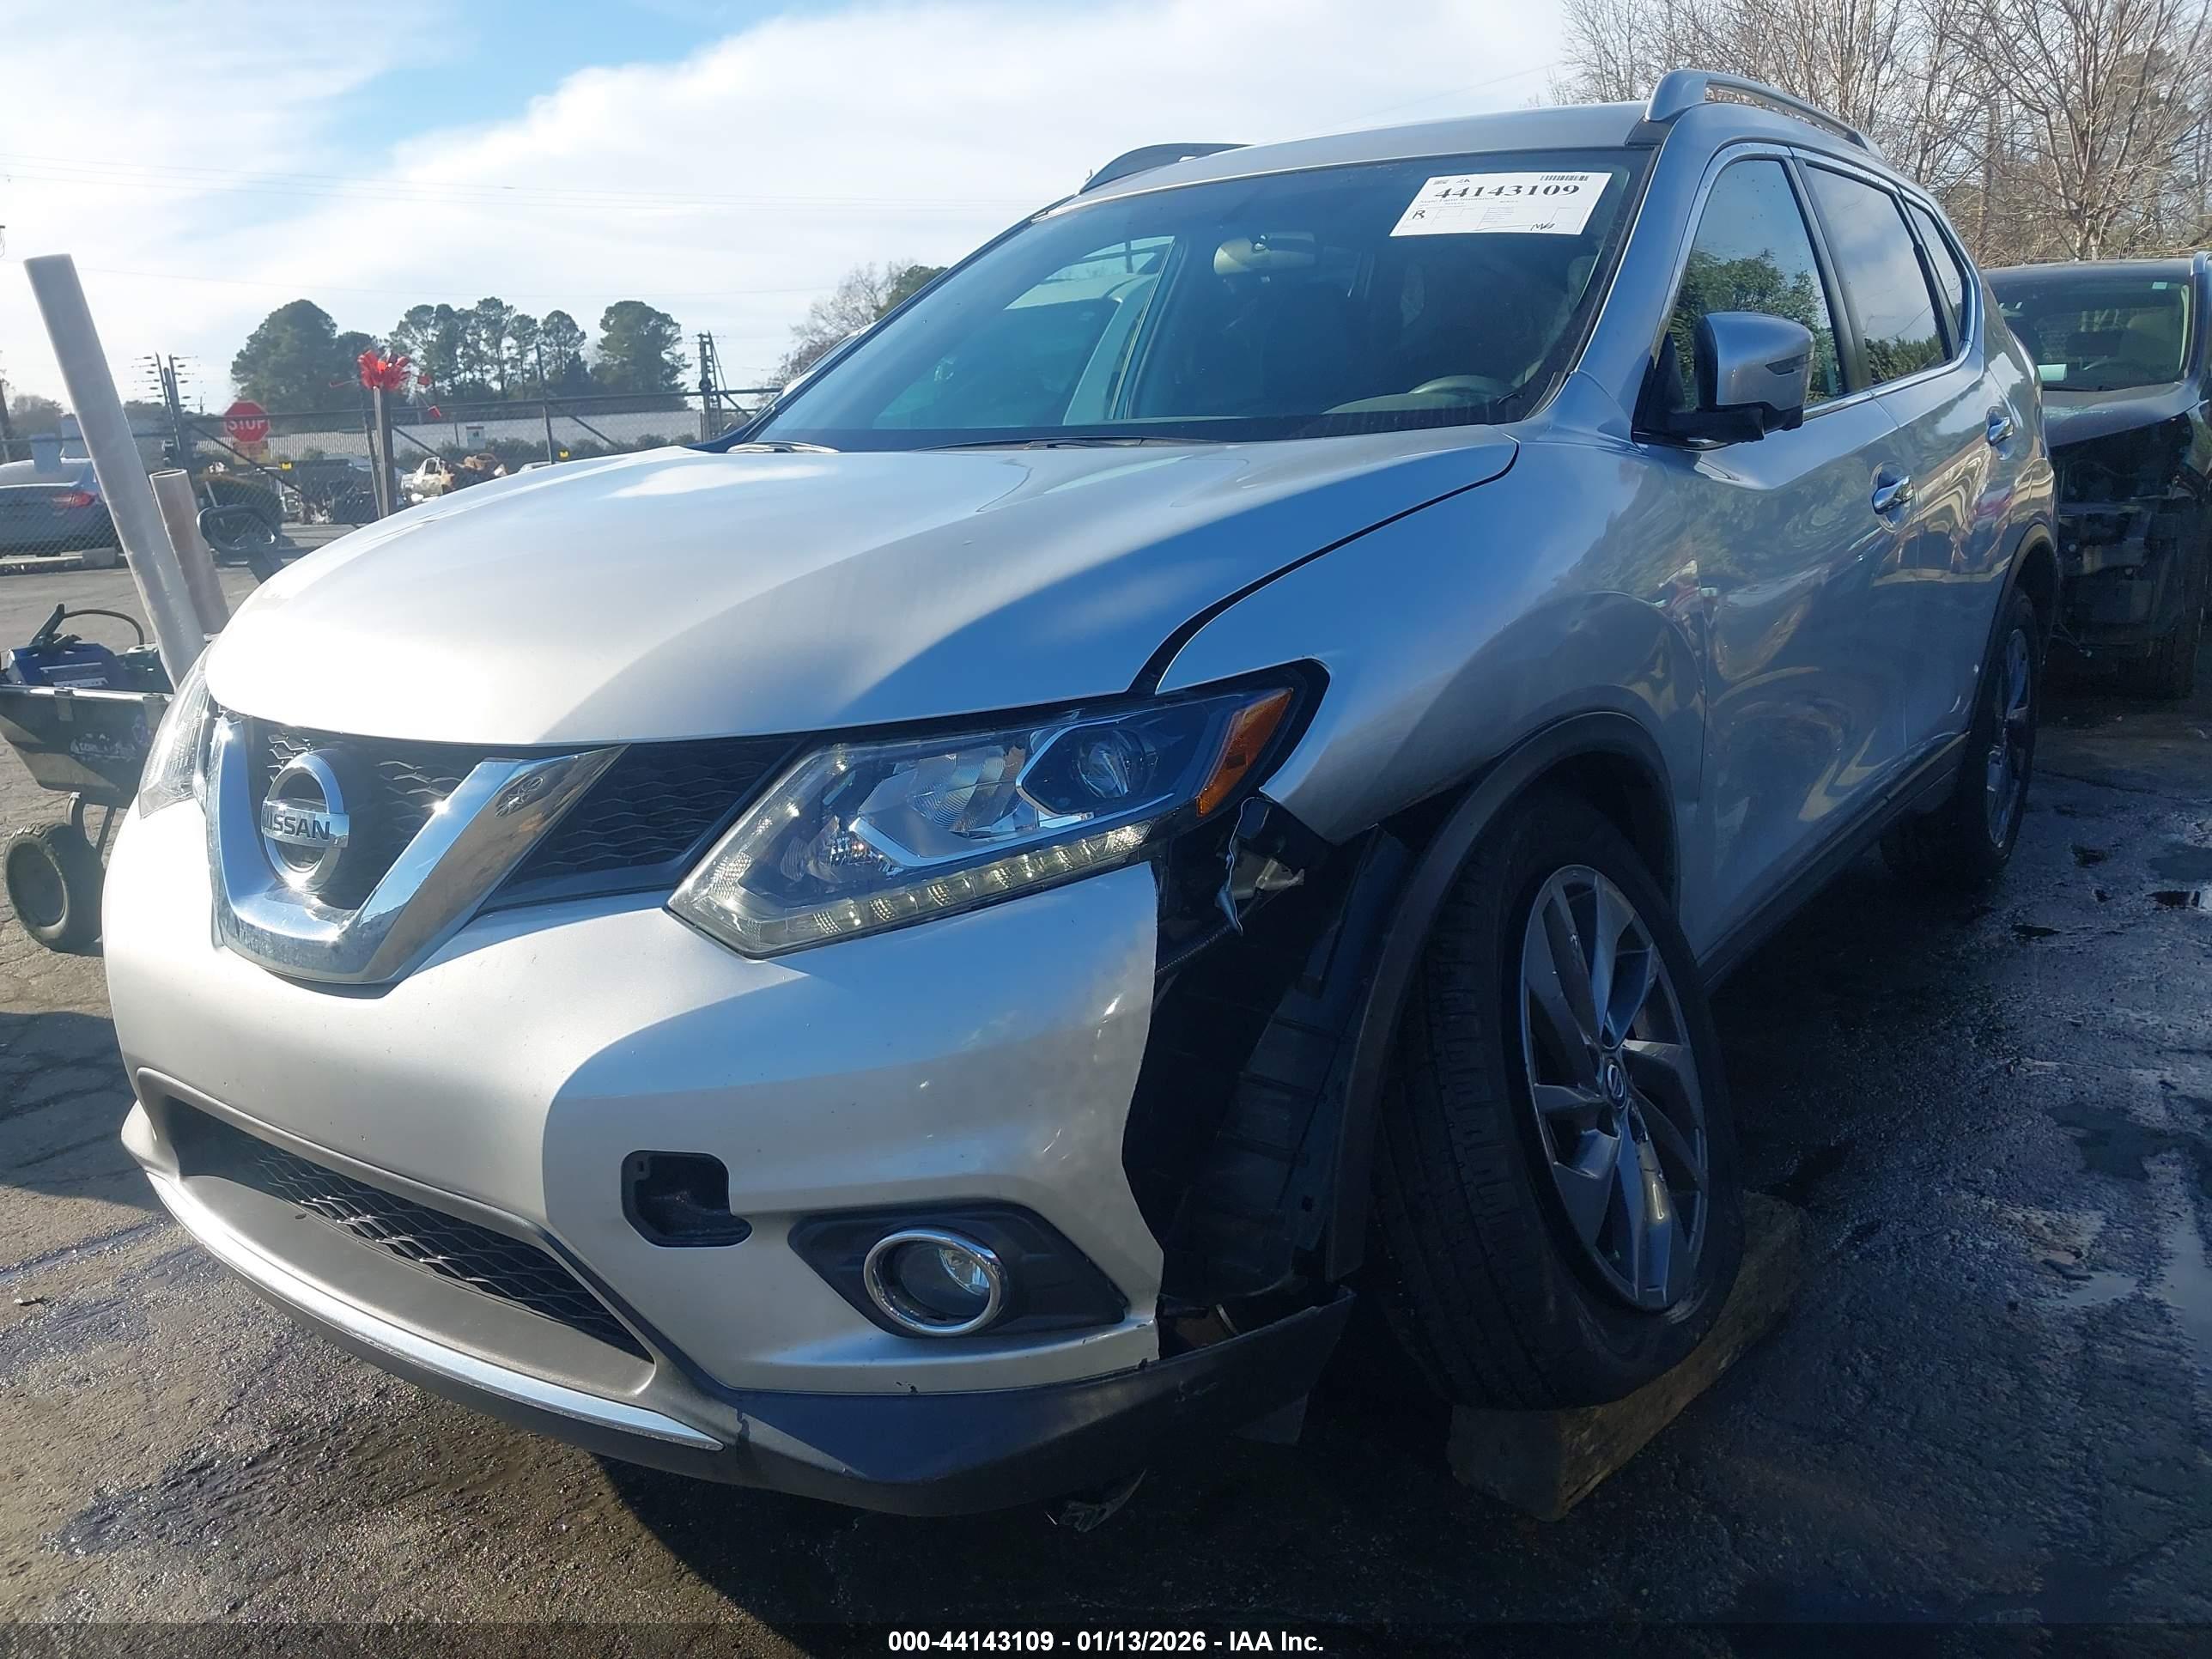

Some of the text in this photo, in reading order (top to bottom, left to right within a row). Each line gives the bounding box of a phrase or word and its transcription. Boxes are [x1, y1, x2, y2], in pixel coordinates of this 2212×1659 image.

[1434, 185, 1580, 198] 44143109
[1413, 210, 1425, 220] R
[262, 810, 331, 840] NISSAN
